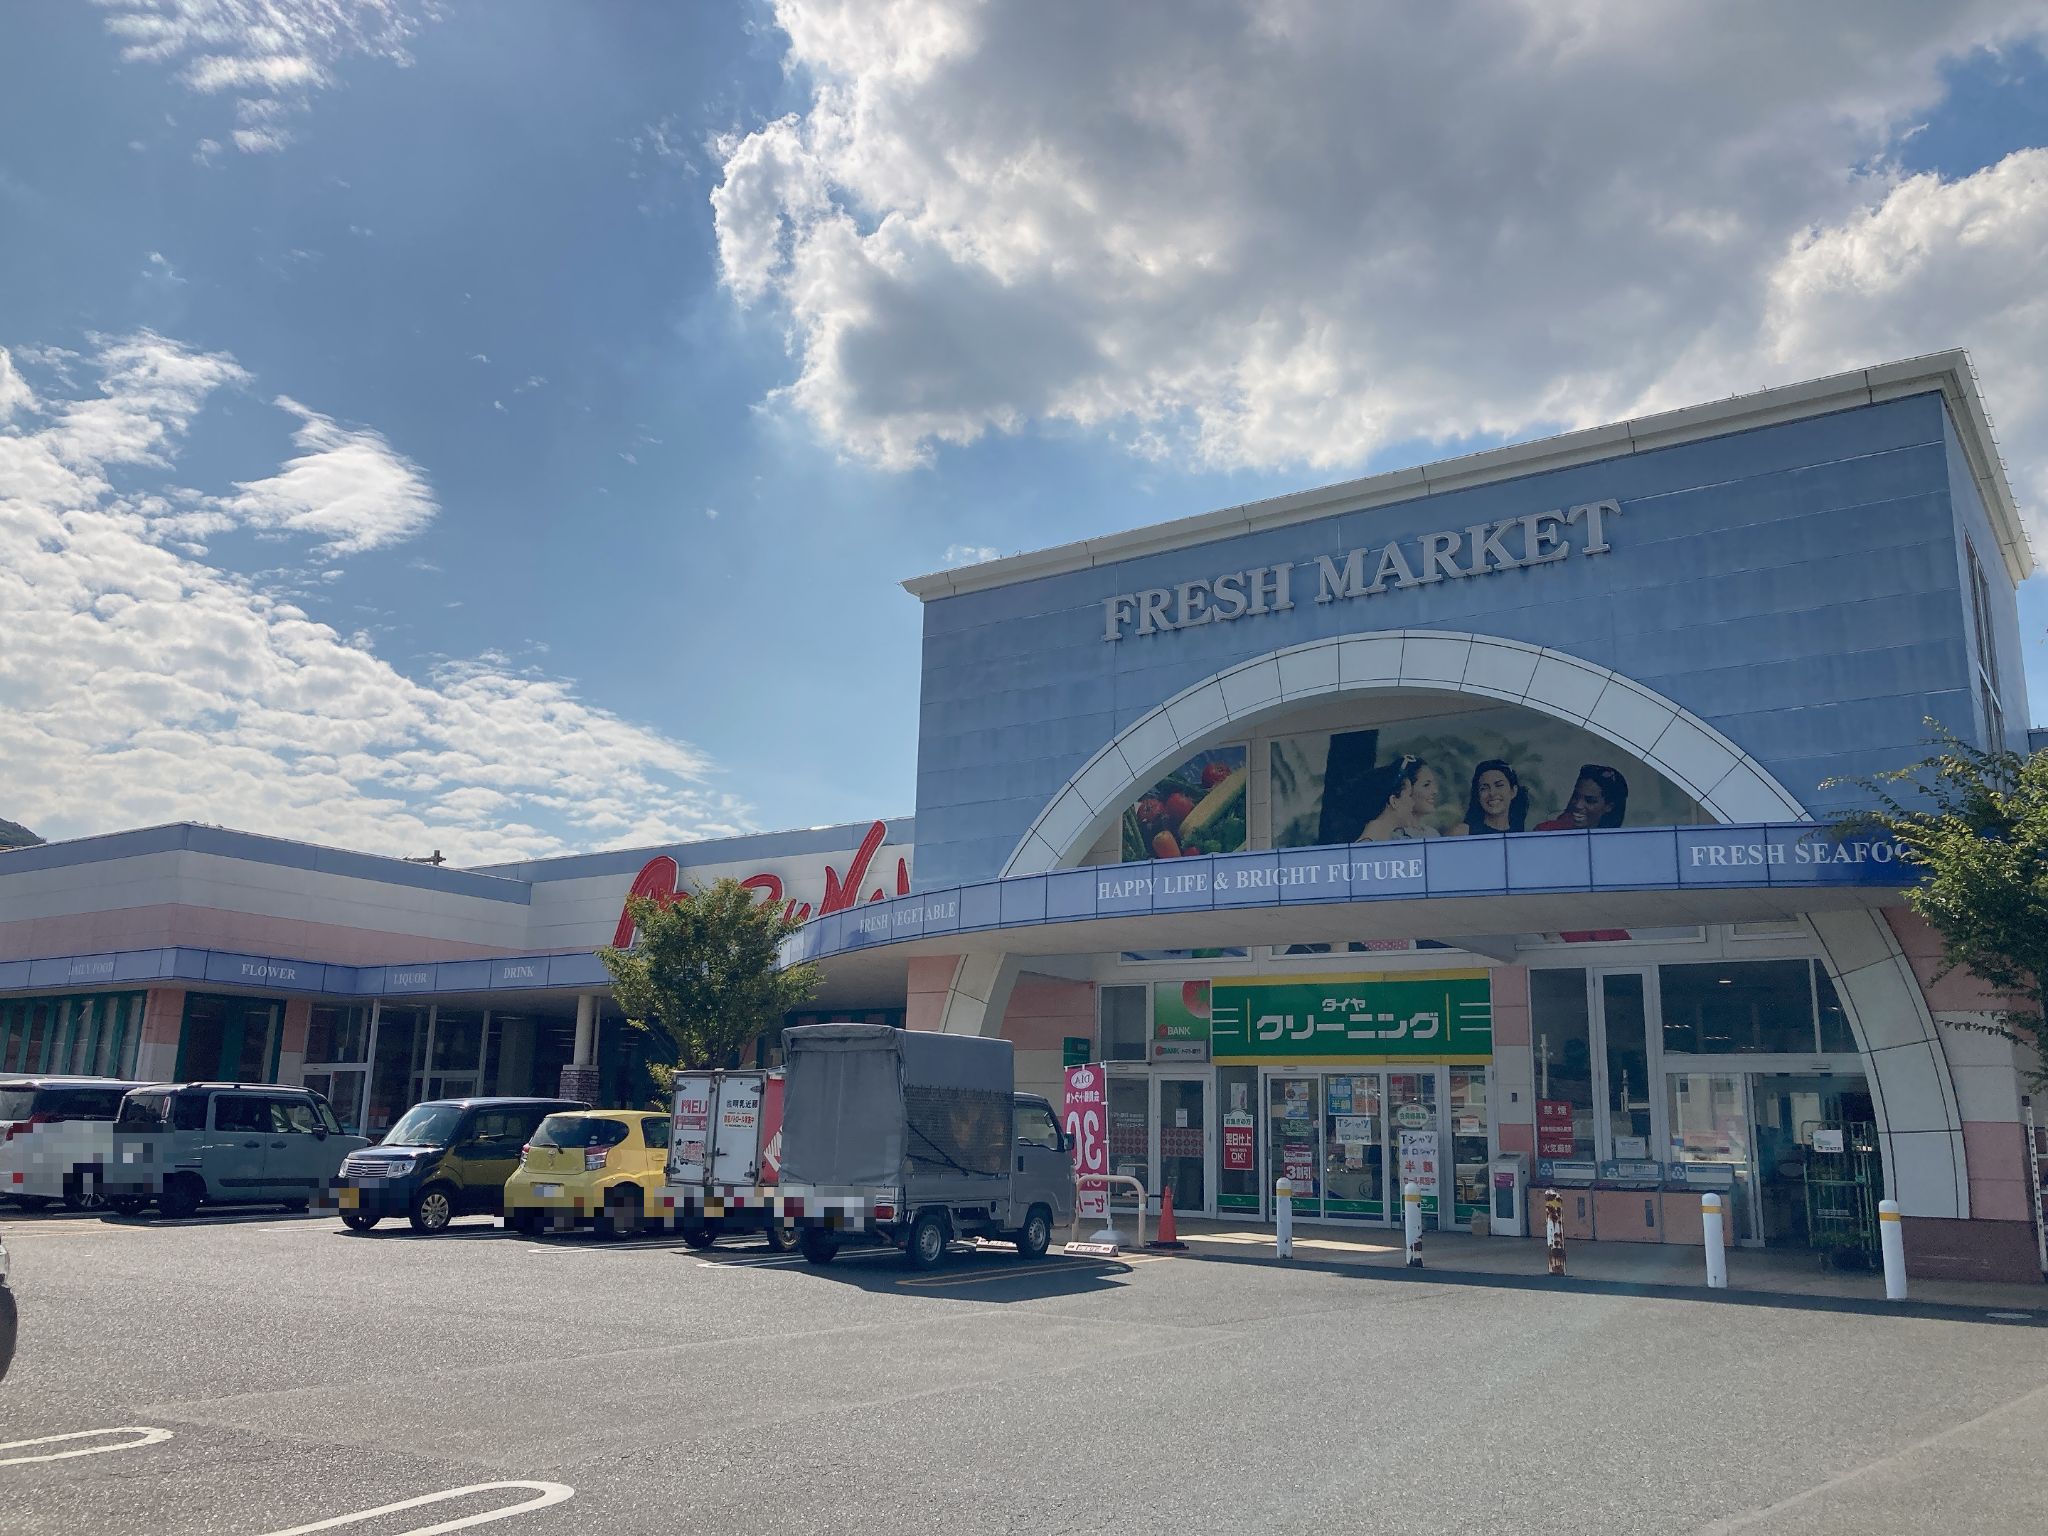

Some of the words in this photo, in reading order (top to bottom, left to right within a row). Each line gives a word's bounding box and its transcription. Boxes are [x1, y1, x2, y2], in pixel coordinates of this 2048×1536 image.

[1103, 562, 1295, 642] FRESH
[1314, 498, 1623, 603] MARKET
[1690, 843, 1787, 867] FRESH
[1098, 877, 1157, 900] HAPPY
[1164, 873, 1207, 894] LIFE
[1213, 871, 1228, 890] &
[1236, 865, 1321, 889] BRIGHT
[1328, 858, 1423, 883] FUTURE
[859, 914, 888, 934] FRESH
[891, 902, 956, 927] VEGETABLE
[241, 963, 296, 980] FLOWER
[394, 972, 427, 985] LIQUOR
[503, 966, 535, 979] DRINK
[1167, 1026, 1191, 1036] BANK
[1256, 1012, 1439, 1041] クリーニング
